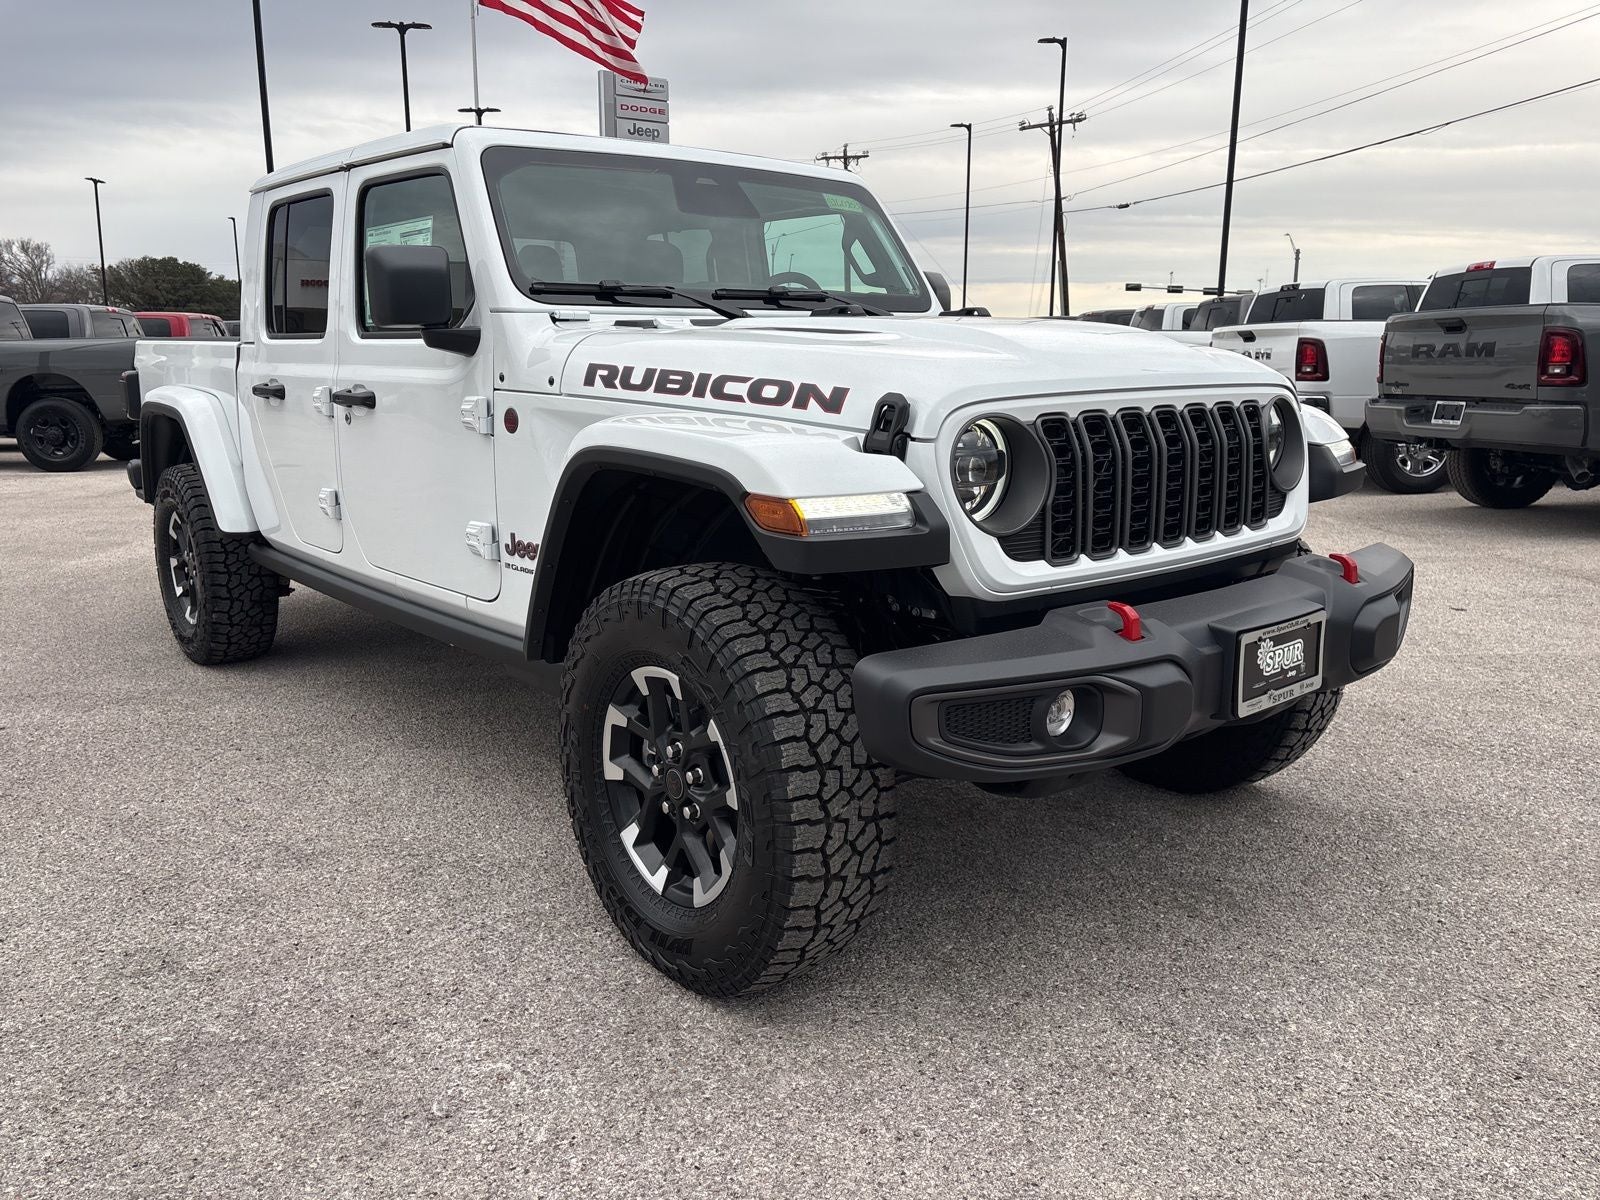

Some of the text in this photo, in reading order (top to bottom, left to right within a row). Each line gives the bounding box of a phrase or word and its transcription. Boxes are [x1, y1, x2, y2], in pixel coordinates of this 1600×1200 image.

[620, 103, 666, 116] DODGE
[627, 122, 660, 140] Jeep
[1411, 341, 1497, 359] RAM
[583, 362, 850, 415] RUBICON
[1264, 640, 1304, 673] SPUR
[1272, 689, 1295, 704] SPUR
